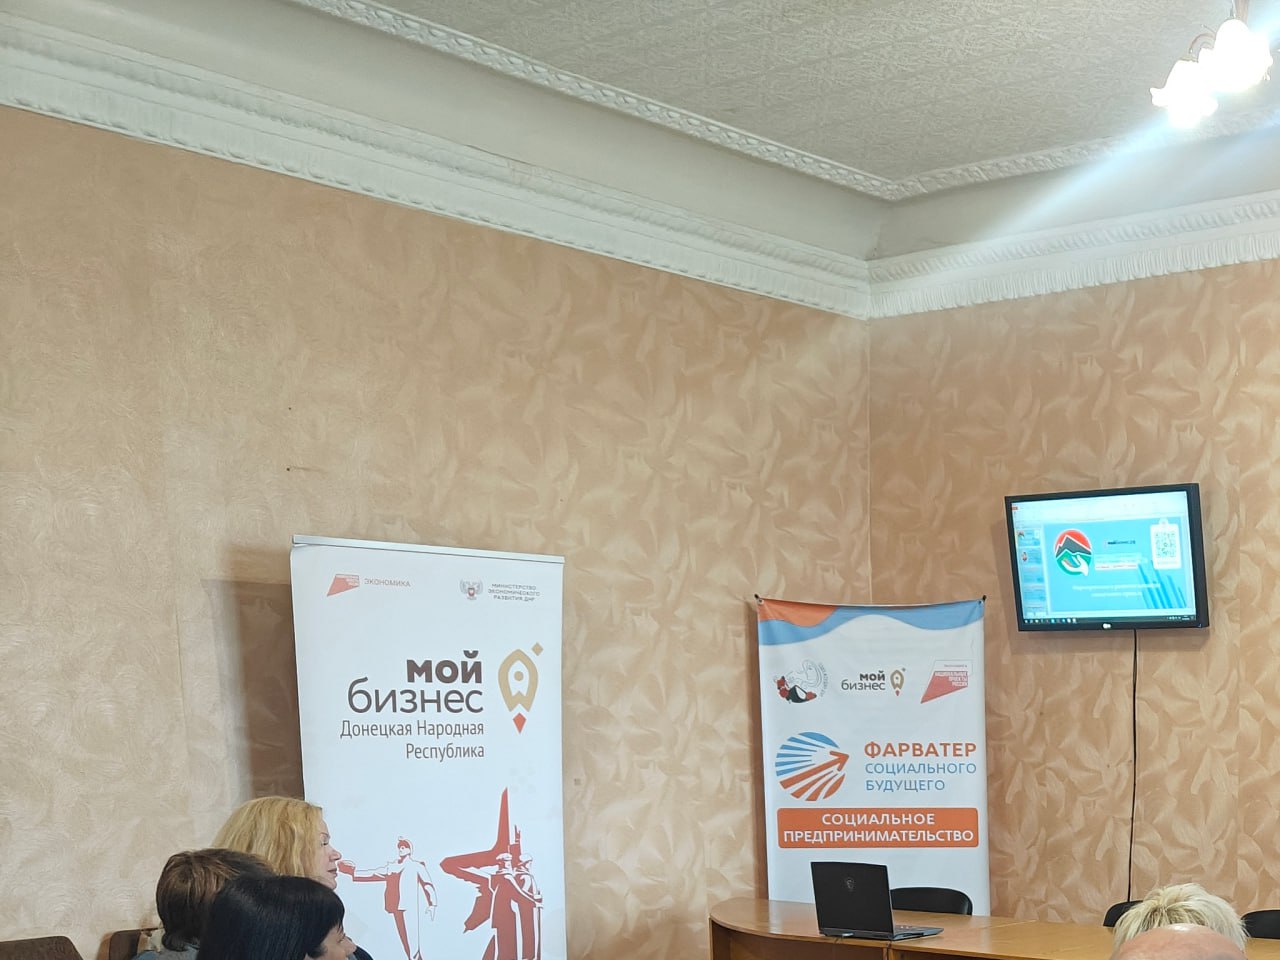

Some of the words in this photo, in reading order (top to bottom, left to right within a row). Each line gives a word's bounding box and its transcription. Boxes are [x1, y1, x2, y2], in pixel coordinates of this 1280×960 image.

[364, 578, 411, 588] ЭКОНОМИКА
[406, 650, 482, 684] мой
[860, 670, 886, 681] мой
[841, 678, 886, 691] бизнес
[347, 676, 484, 714] бизнес
[340, 719, 412, 739] Донецкая
[416, 719, 484, 740] Народная
[406, 742, 485, 763] Республика
[864, 741, 977, 759] ФАРВАТЕР
[864, 763, 977, 776] СОЦИАЛЬНОГО
[865, 780, 945, 793] БУДУЩЕГО
[821, 813, 936, 827] СОЦИАЛЬНОЕ
[783, 830, 974, 844] ПРЕДПРИНИМАТЕЛЬСТВО
